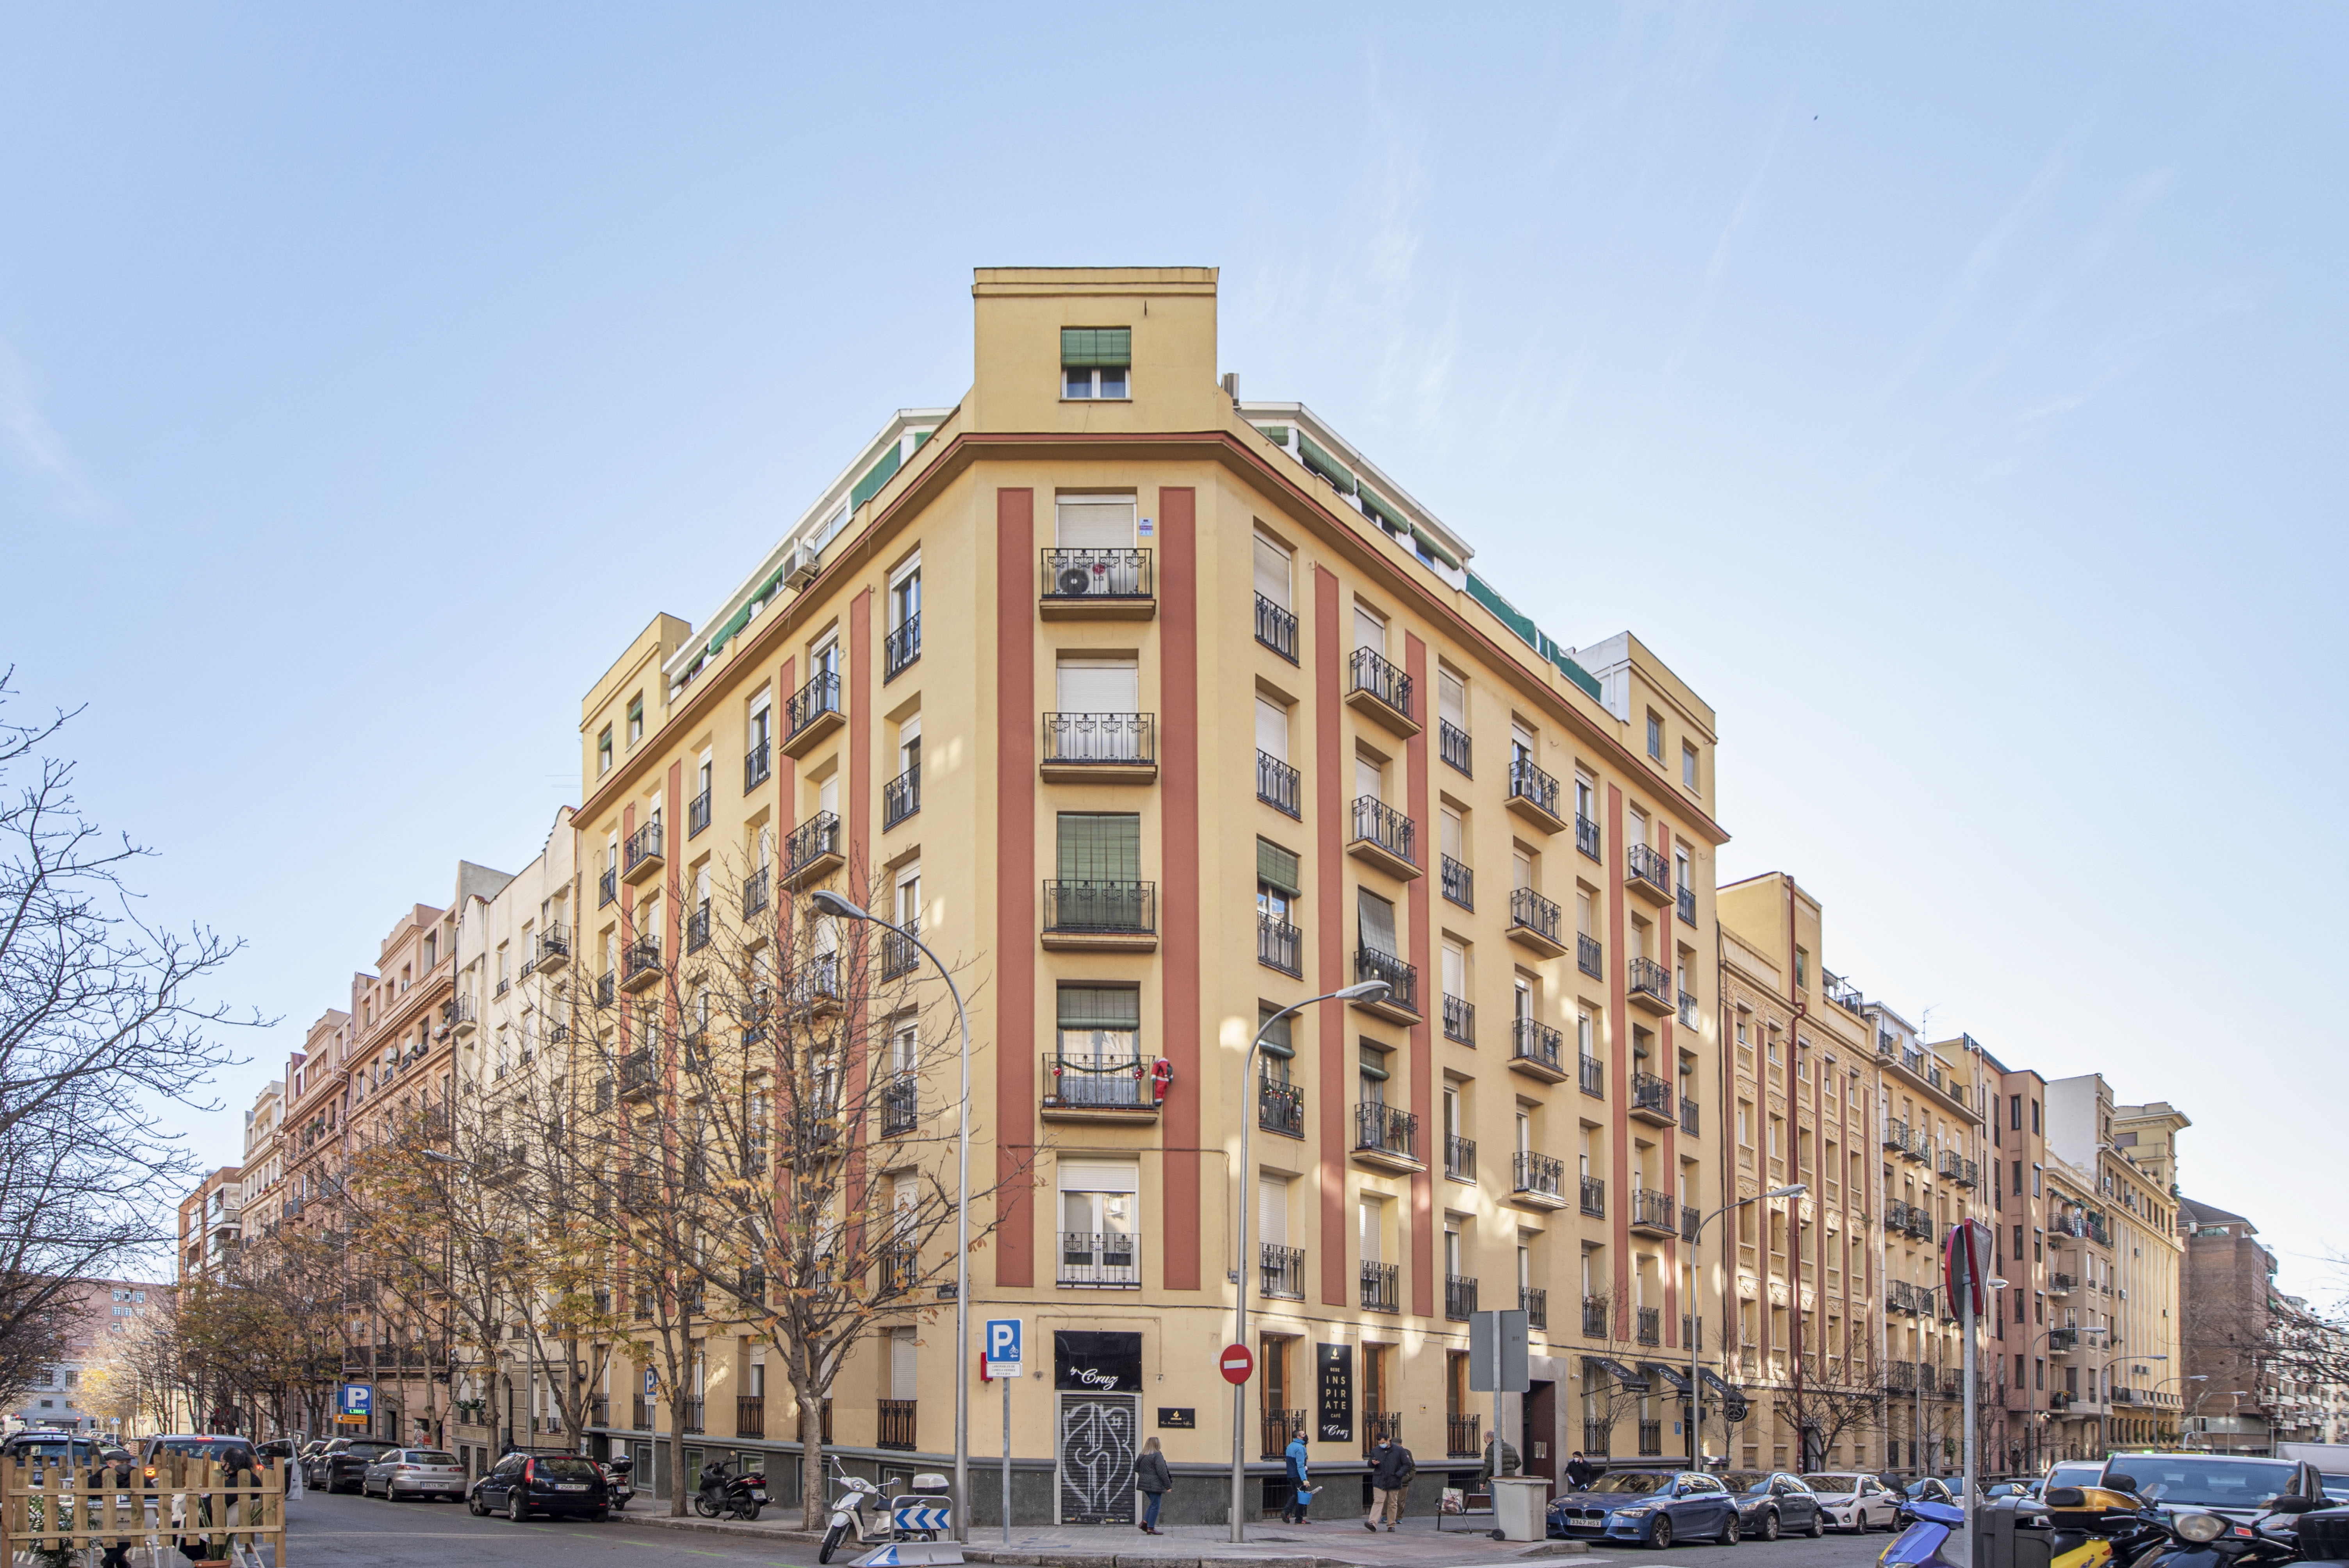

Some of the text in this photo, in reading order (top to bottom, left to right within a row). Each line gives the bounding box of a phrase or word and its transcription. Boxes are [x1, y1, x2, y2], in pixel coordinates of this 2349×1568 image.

[993, 1325, 1014, 1358] P
[1078, 1368, 1118, 1390] Cruz
[1326, 1376, 1346, 1384] INS
[348, 1387, 368, 1408] P
[1326, 1389, 1346, 1398] PIR
[1325, 1401, 1346, 1409] ATE
[1327, 1425, 1349, 1439] Cruz
